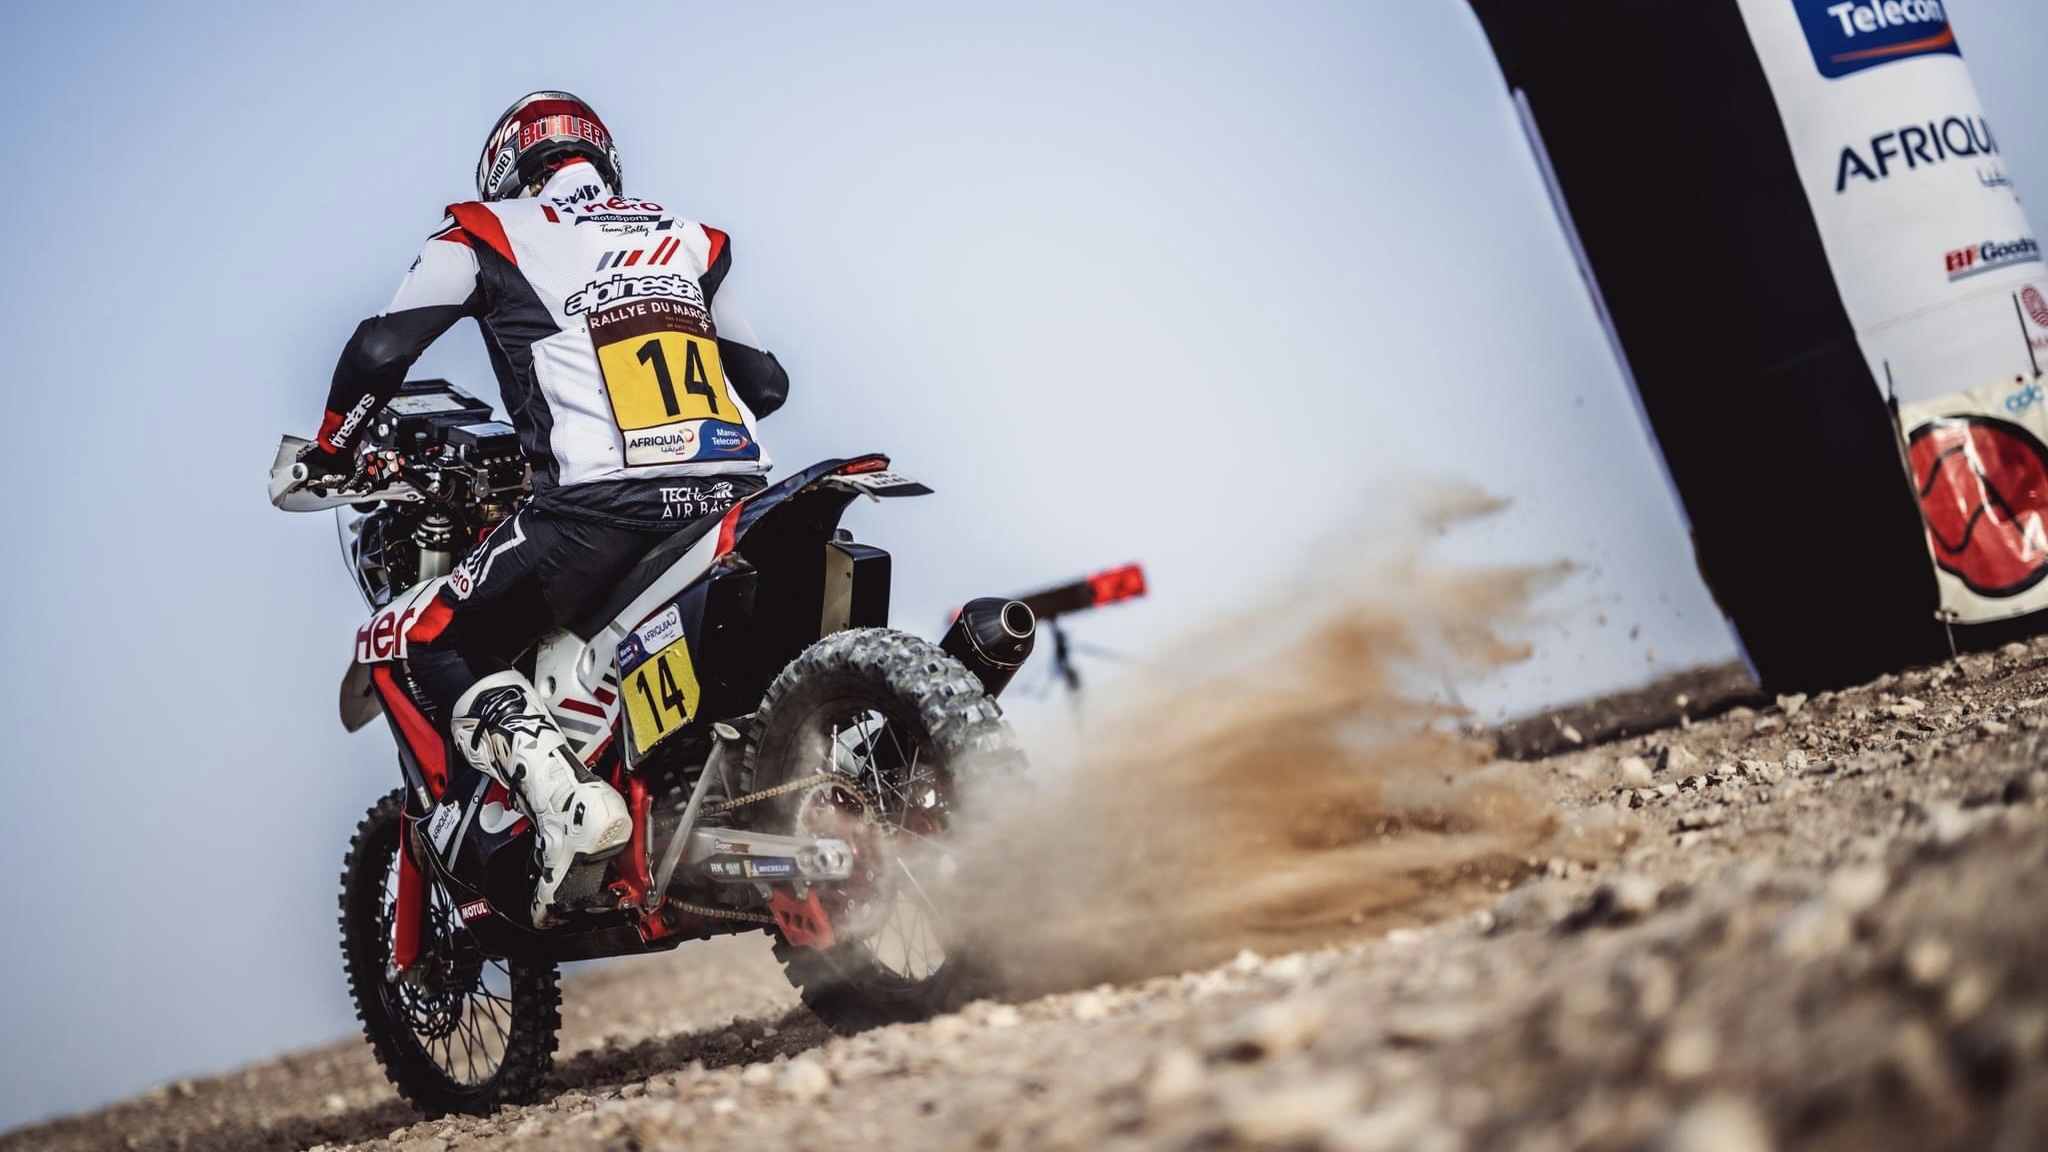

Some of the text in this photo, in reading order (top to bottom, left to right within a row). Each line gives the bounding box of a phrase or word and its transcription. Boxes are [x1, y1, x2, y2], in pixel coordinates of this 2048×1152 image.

[1835, 115, 1999, 194] AFRIQU
[489, 153, 511, 190] SHOEI
[600, 224, 650, 237] Team Rally
[590, 303, 647, 329] RALLYE
[652, 301, 670, 313] DU
[636, 339, 719, 417] 14
[629, 434, 685, 449] AFRIQUIA
[712, 436, 741, 445] Telecom
[660, 503, 692, 520] AIR
[355, 607, 415, 660] Her
[643, 620, 672, 643] AFRIQUIA
[636, 655, 688, 734] 14
[710, 863, 724, 873] RK
[461, 902, 487, 920] MOTUL
